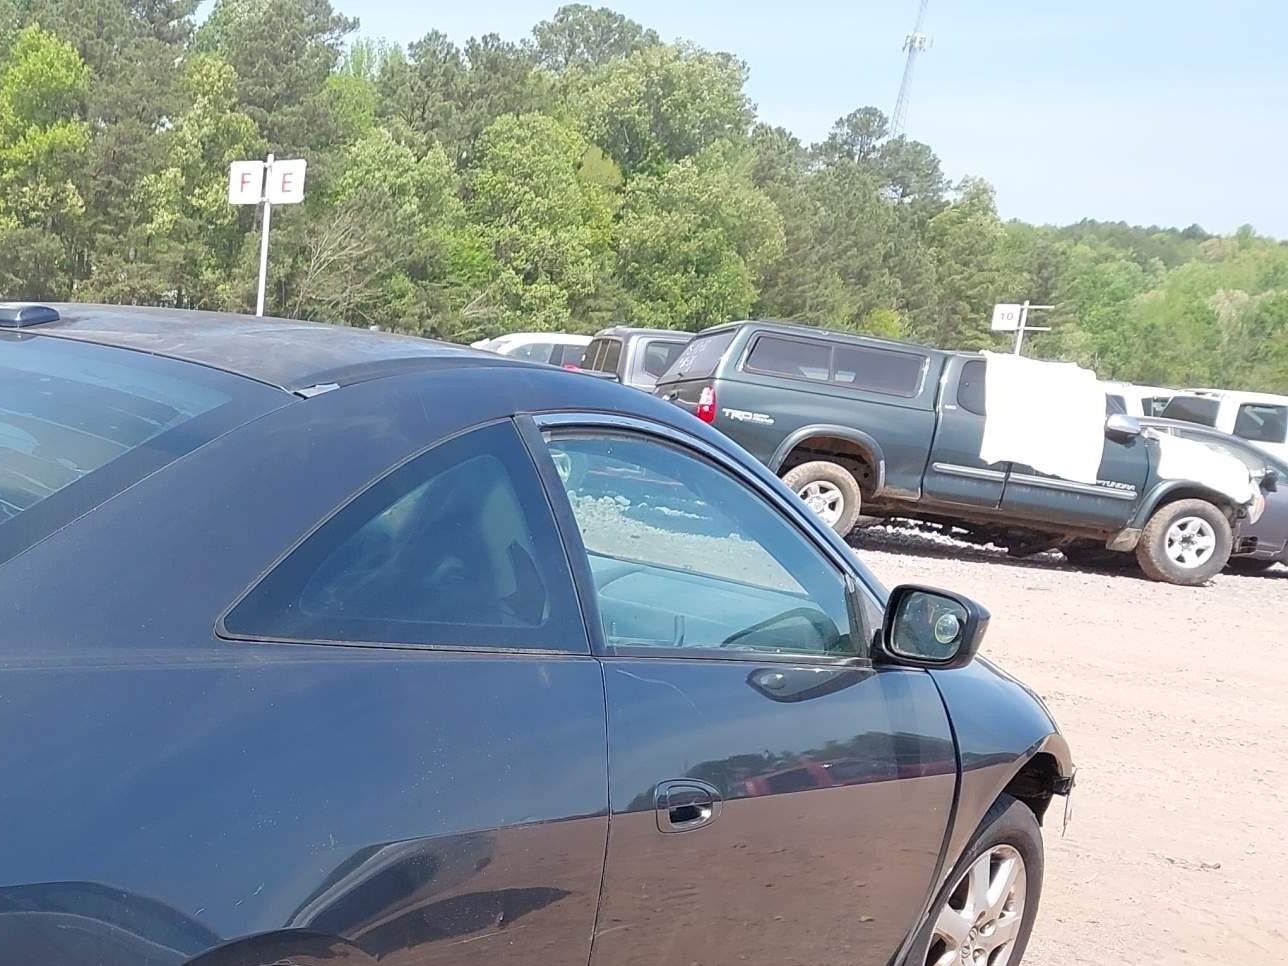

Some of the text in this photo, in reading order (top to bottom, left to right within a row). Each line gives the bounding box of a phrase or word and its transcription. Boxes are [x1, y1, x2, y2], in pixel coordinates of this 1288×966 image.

[240, 172, 293, 193] F E
[1000, 312, 1014, 321] 10
